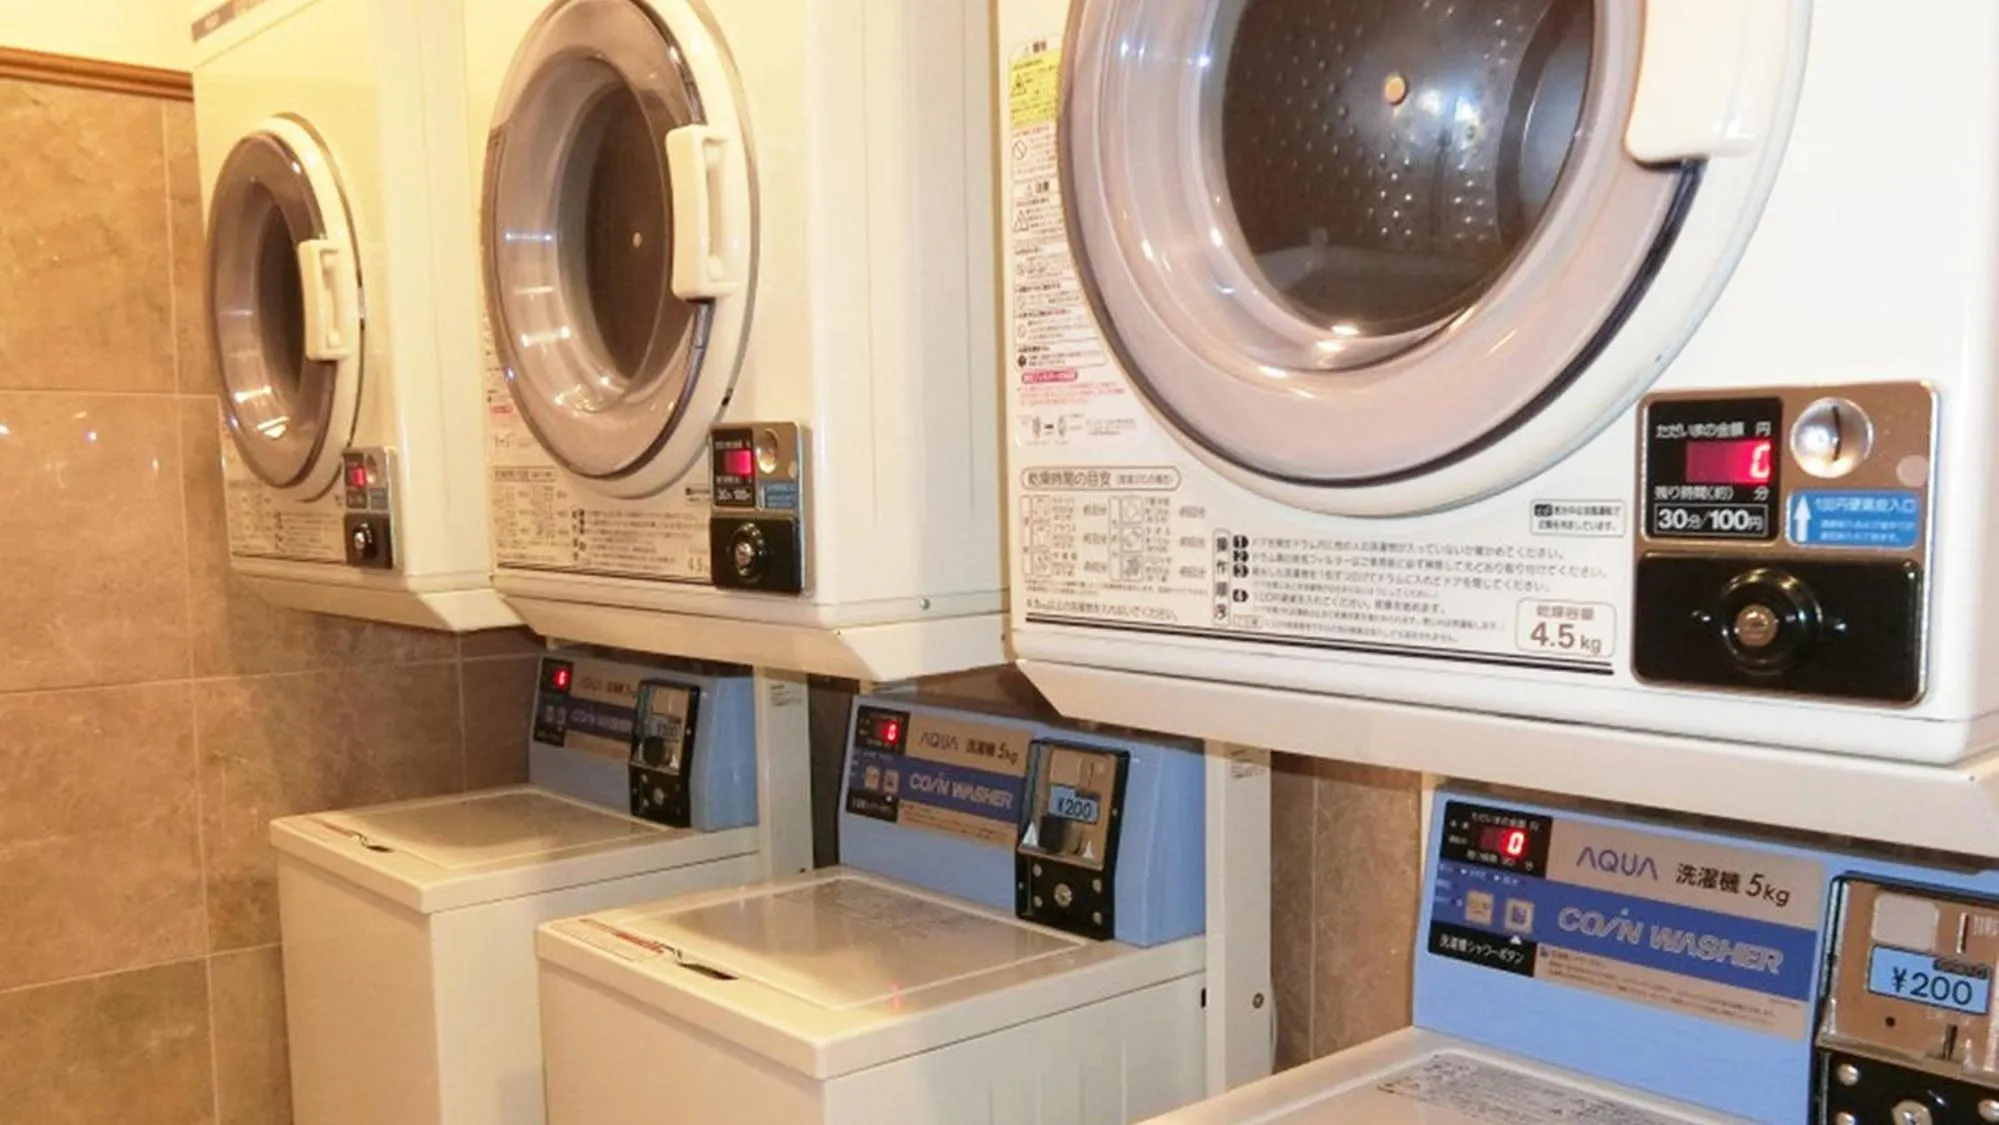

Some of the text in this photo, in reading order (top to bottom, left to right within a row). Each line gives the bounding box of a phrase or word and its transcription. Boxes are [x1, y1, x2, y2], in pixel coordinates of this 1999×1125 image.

[1656, 421, 1744, 438] ただいまの金額
[1531, 622, 1575, 649] 4.5
[952, 780, 1015, 811] WASHER
[1507, 831, 1525, 855] 0
[1576, 846, 1791, 908] AQUA 洗濯機 5kg
[1650, 924, 1785, 976] WASHER
[1891, 965, 1973, 1006] ¥200
